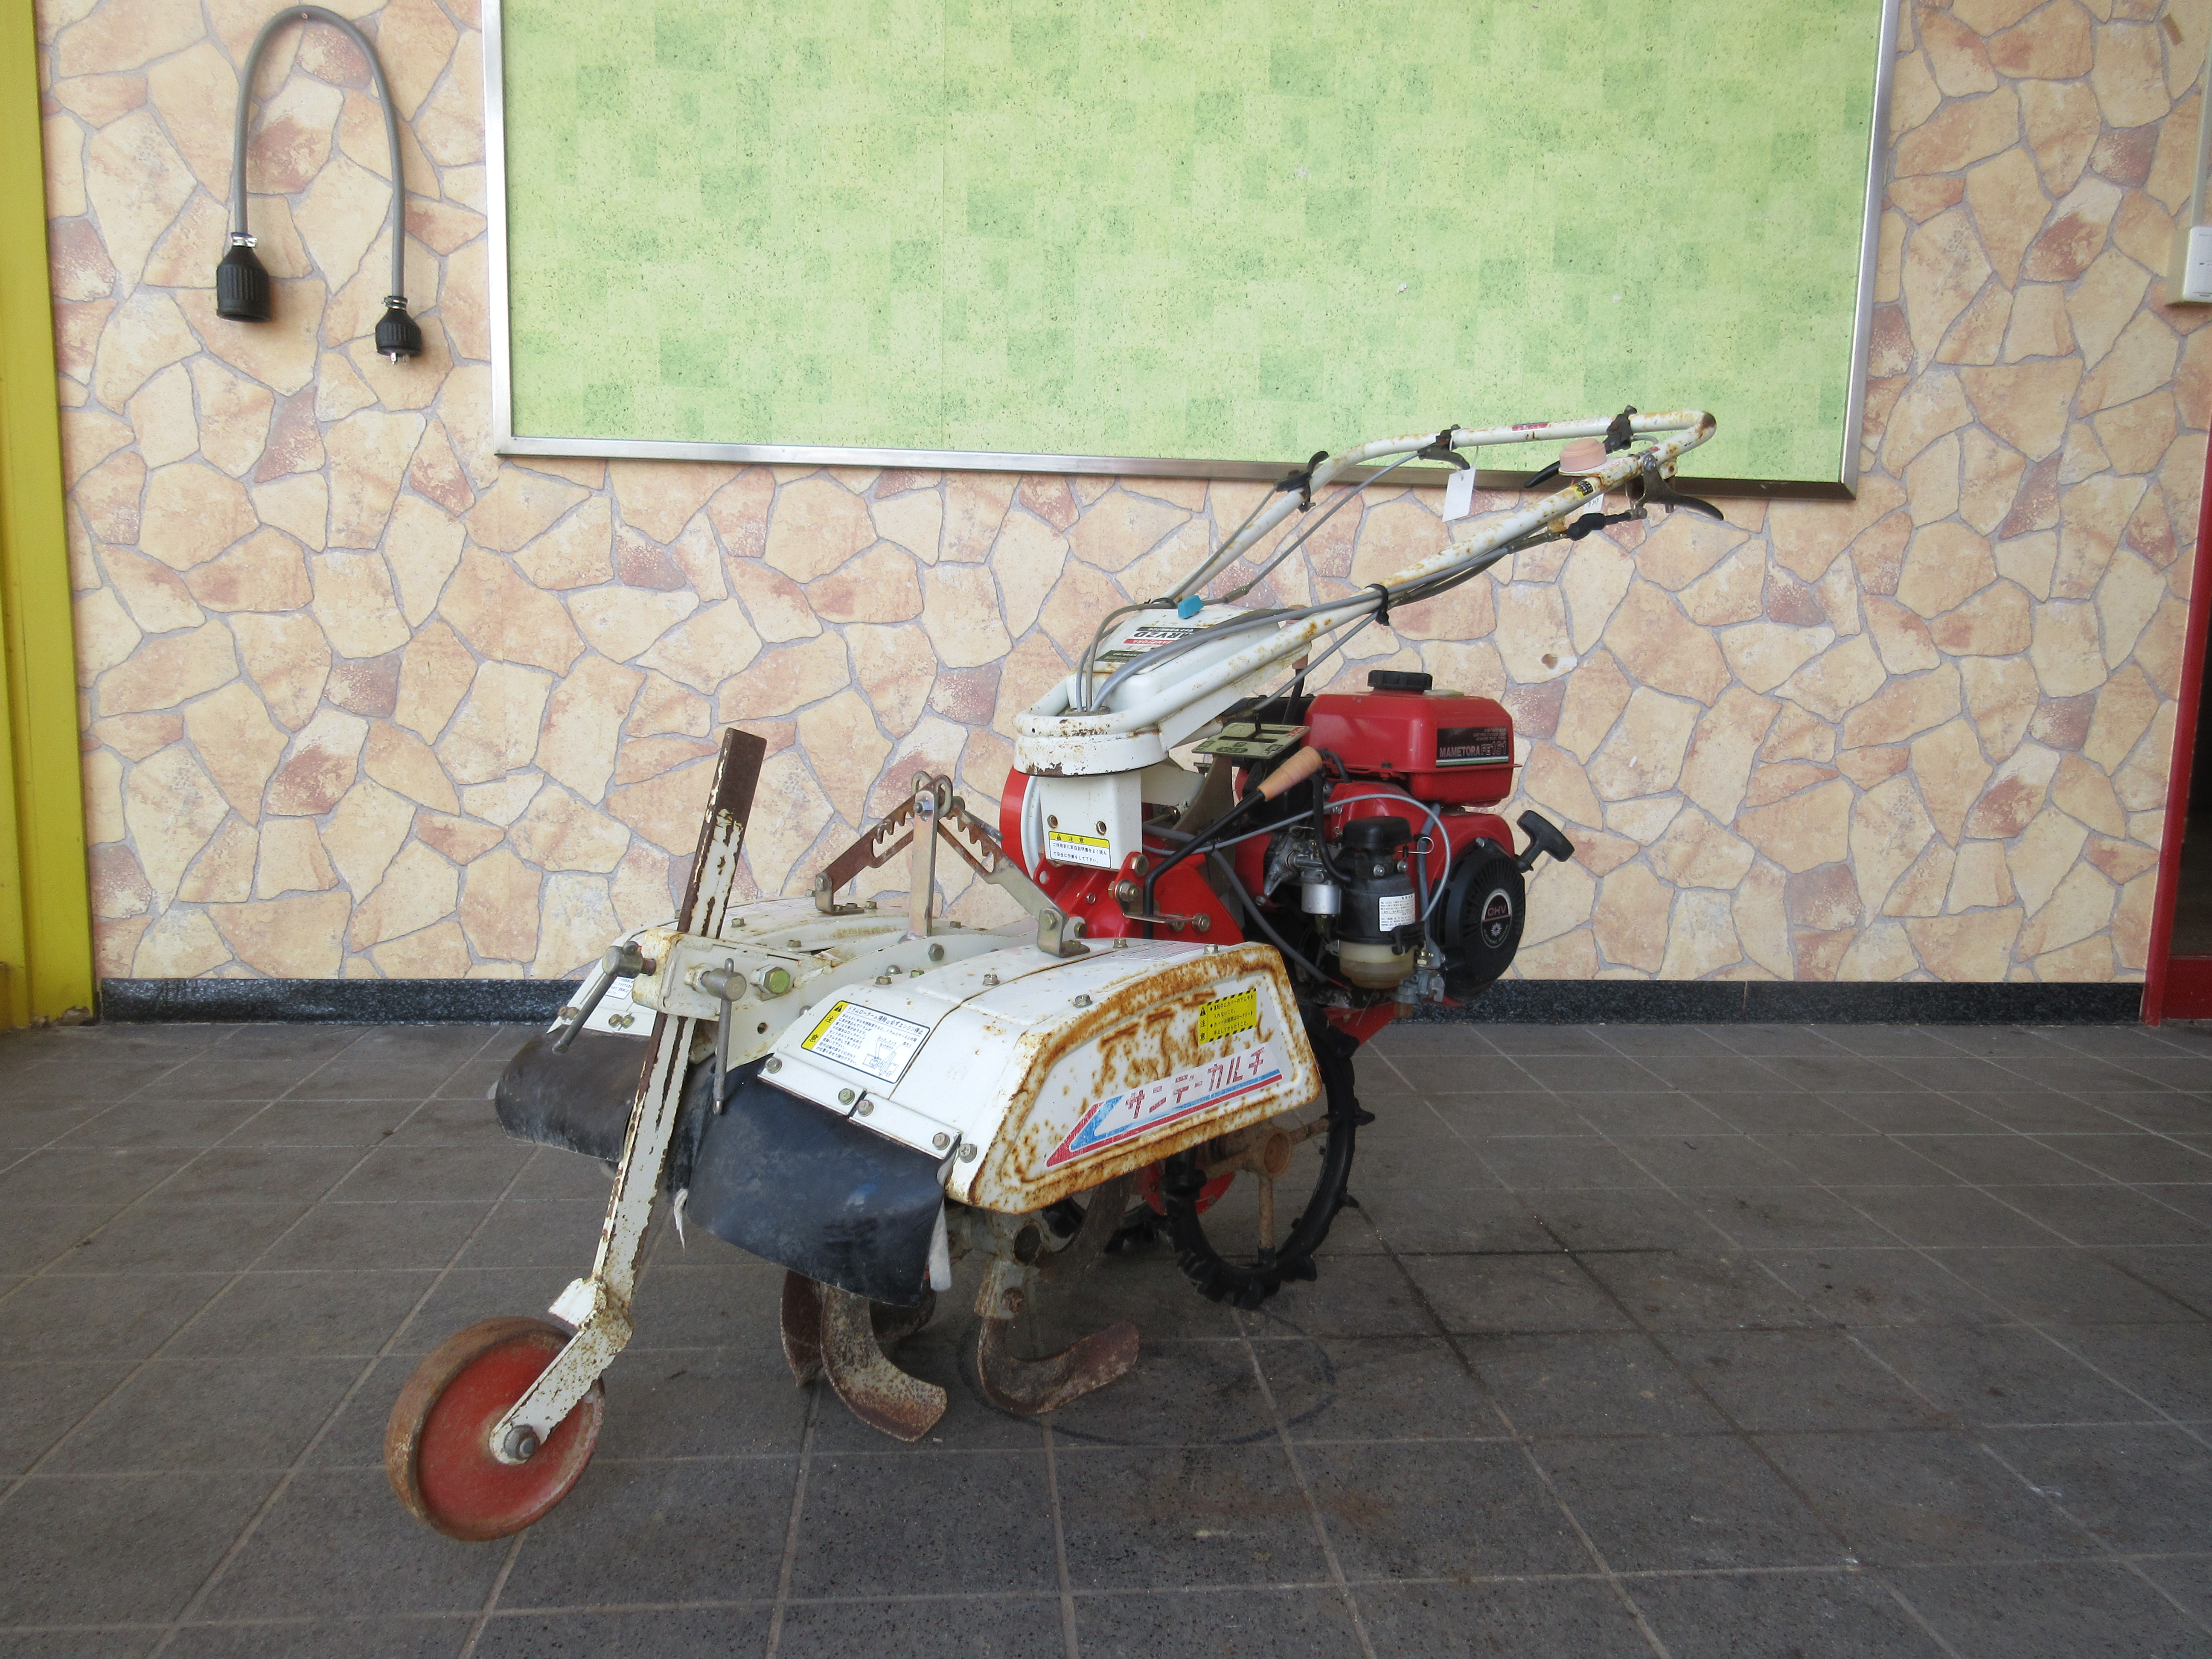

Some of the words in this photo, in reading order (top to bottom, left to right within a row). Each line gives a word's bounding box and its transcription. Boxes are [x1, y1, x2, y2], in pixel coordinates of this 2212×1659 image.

[1440, 746, 1480, 757] MAMETORA
[1481, 741, 1506, 756] FE161
[1068, 835, 1084, 844] 注意
[1053, 842, 1107, 855] ご使用前に取扱説明書をよく読ん
[1054, 852, 1098, 864] で安全に作業をして下さい。
[1487, 905, 1507, 916] OHV
[848, 1006, 924, 1034] ドラムローターの掃除は必ずエンジン停止
[809, 1015, 834, 1043] 注意
[1200, 1020, 1206, 1041] 注意
[1125, 1048, 1265, 1119] サンデーカルチ
